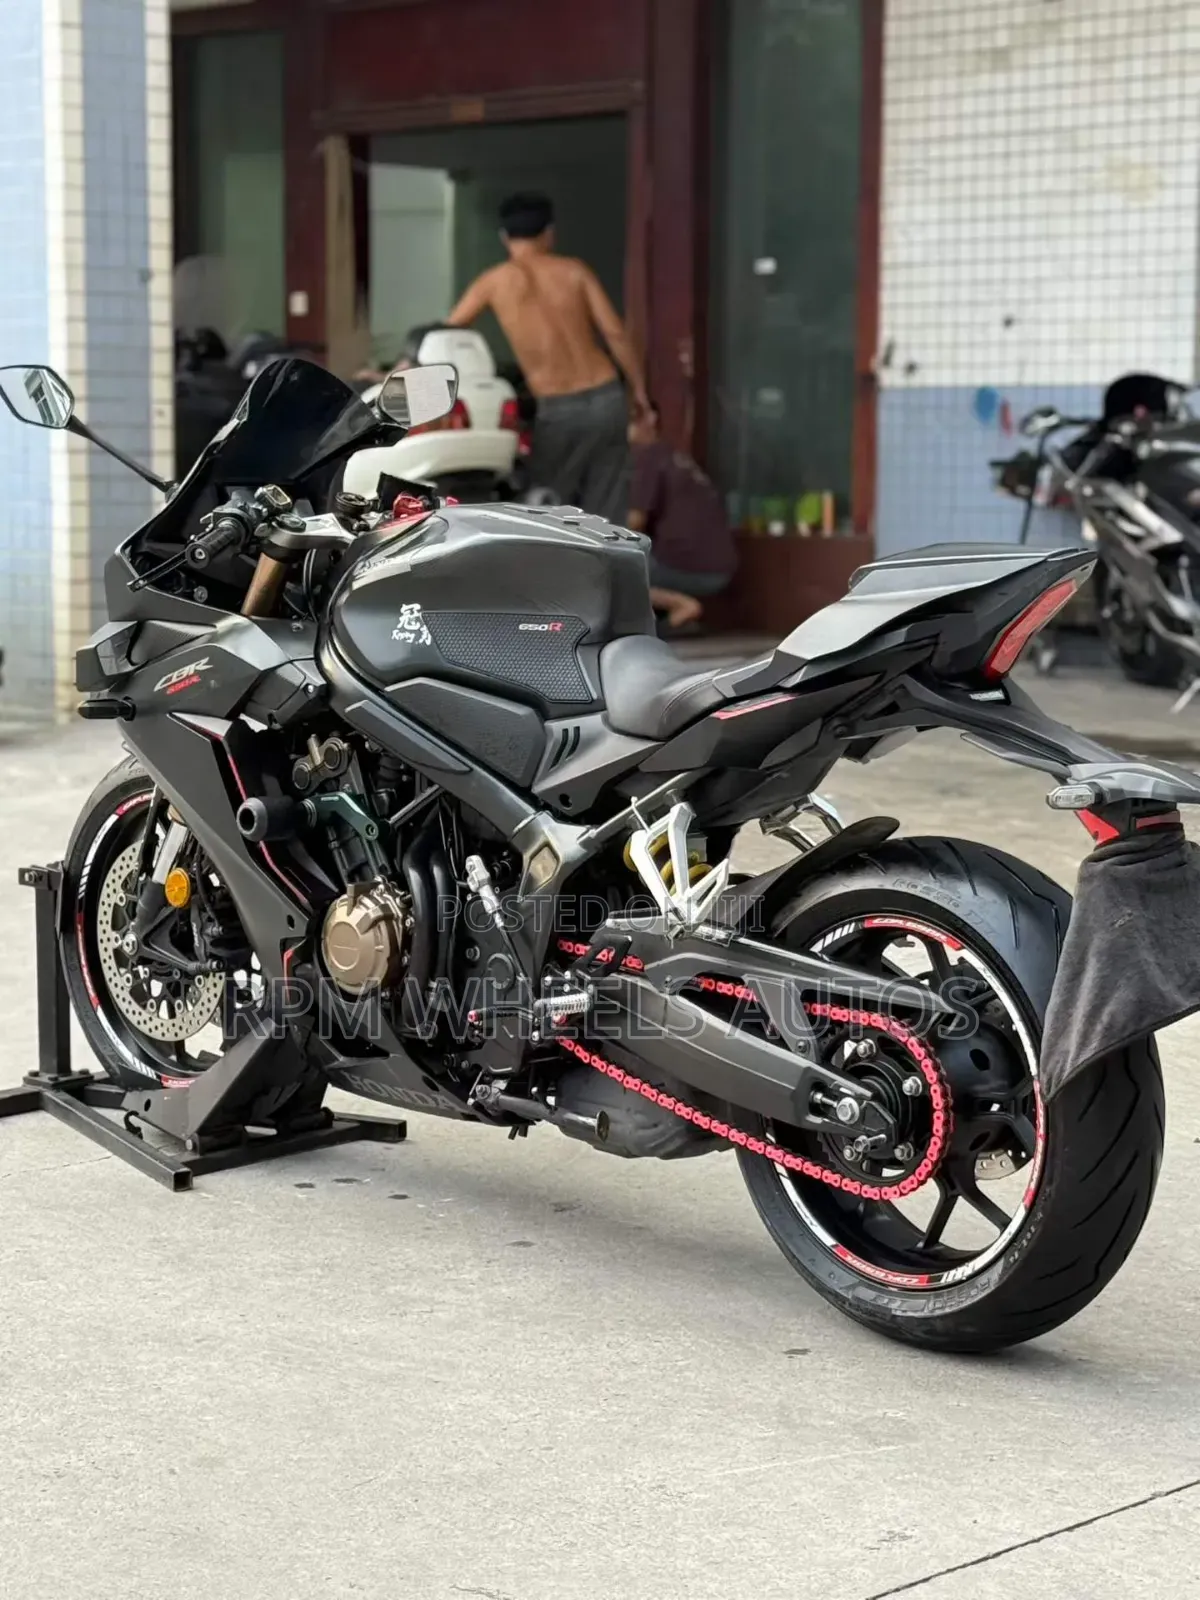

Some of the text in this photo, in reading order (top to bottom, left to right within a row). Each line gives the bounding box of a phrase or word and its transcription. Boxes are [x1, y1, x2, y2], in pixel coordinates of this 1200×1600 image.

[518, 622, 563, 631] 650R
[153, 656, 214, 692] CBR
[340, 1069, 461, 1111] HONDA
